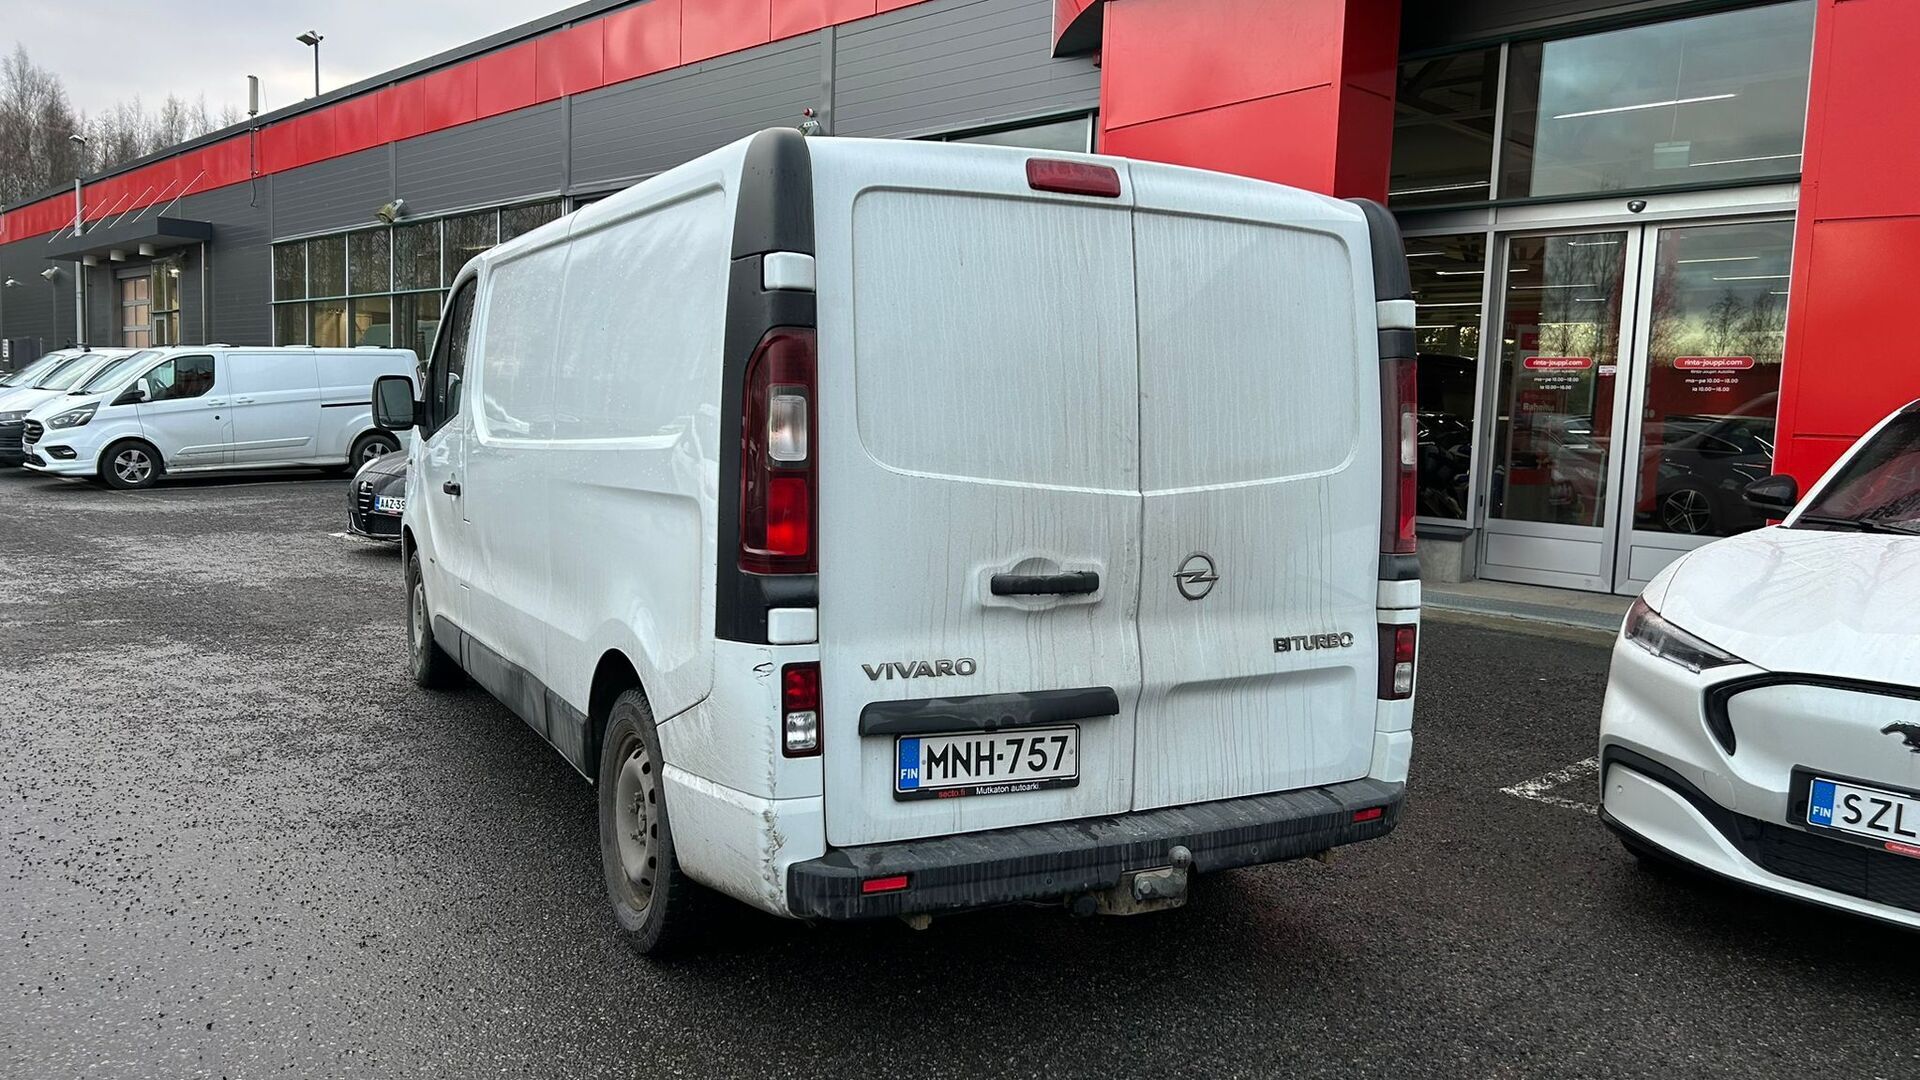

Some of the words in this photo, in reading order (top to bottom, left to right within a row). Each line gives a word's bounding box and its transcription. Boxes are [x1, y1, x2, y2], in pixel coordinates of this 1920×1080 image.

[1533, 359, 1583, 367] rinta-jouppi.com
[1684, 359, 1743, 367] rinta-jouppi.com
[1273, 631, 1354, 653] BITURBO
[861, 657, 977, 681] VIVARO
[900, 767, 919, 780] FIN
[926, 735, 1069, 780] MNH-757
[938, 789, 966, 799] secto.fi
[976, 784, 1010, 796] Mutkaton
[1812, 805, 1832, 818] FIN
